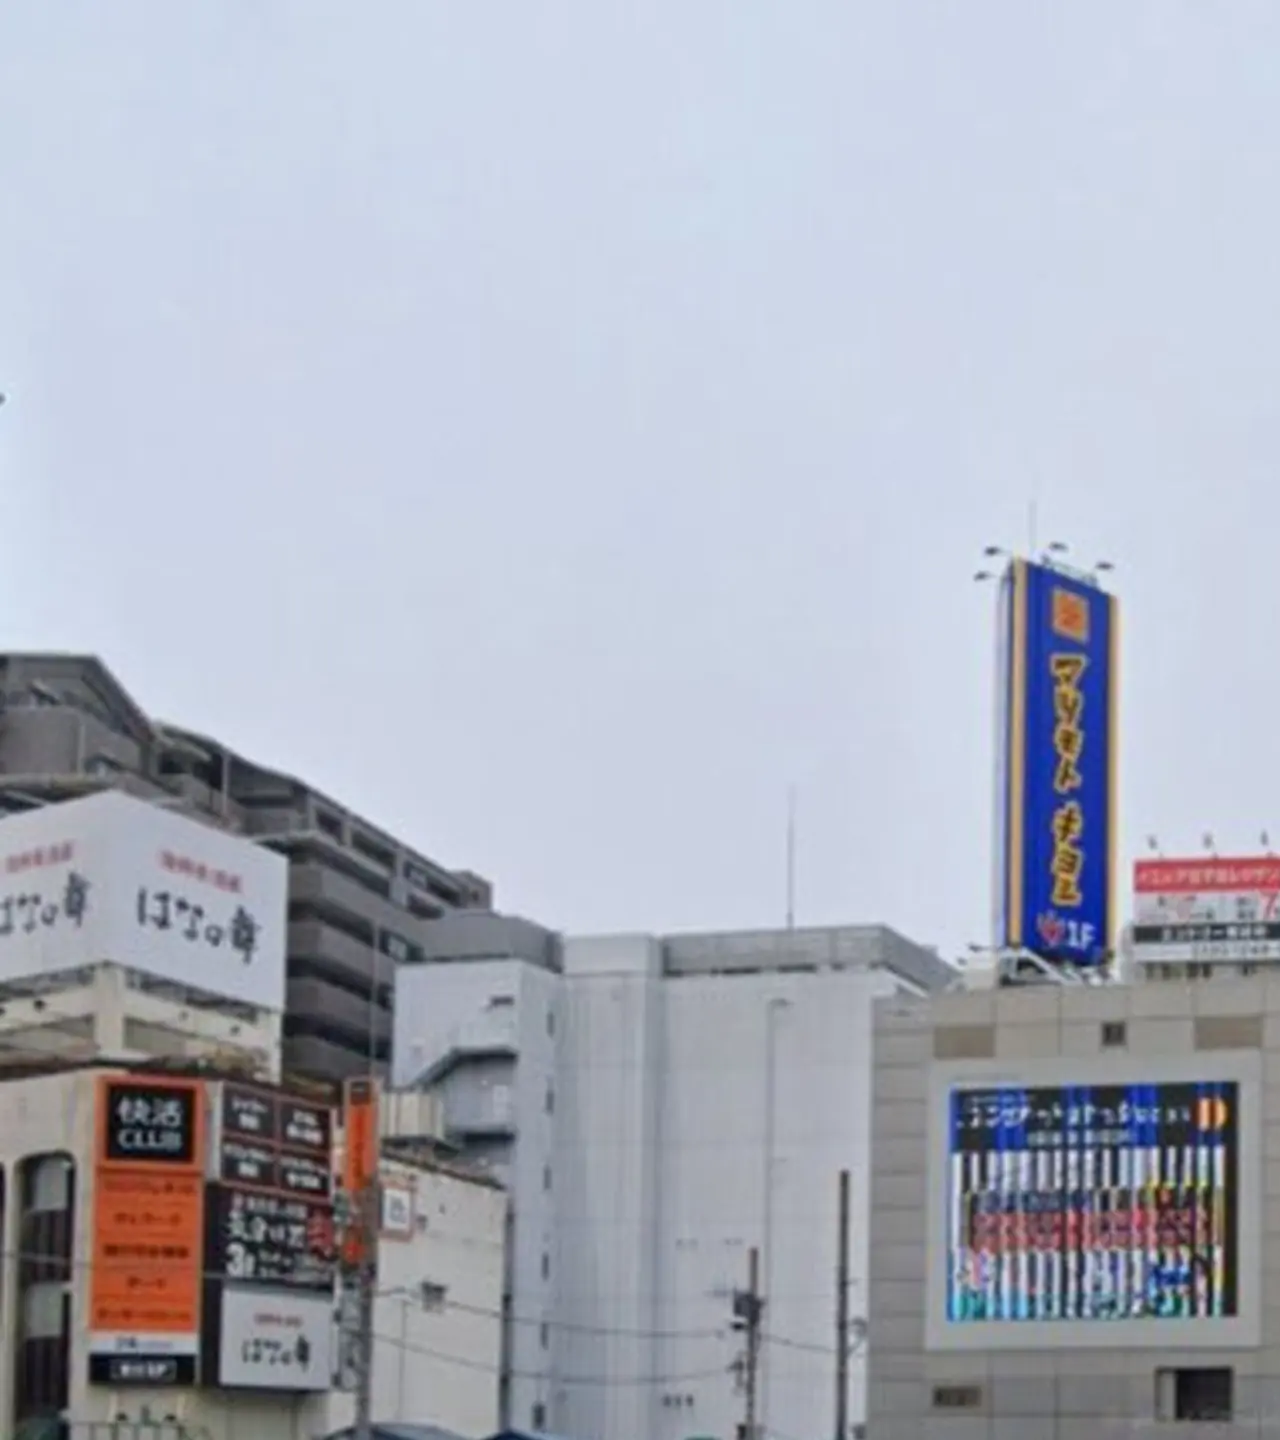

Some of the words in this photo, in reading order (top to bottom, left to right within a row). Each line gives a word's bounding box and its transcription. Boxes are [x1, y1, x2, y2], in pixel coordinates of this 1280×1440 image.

[1050, 654, 1088, 906] マツモトキヨシ
